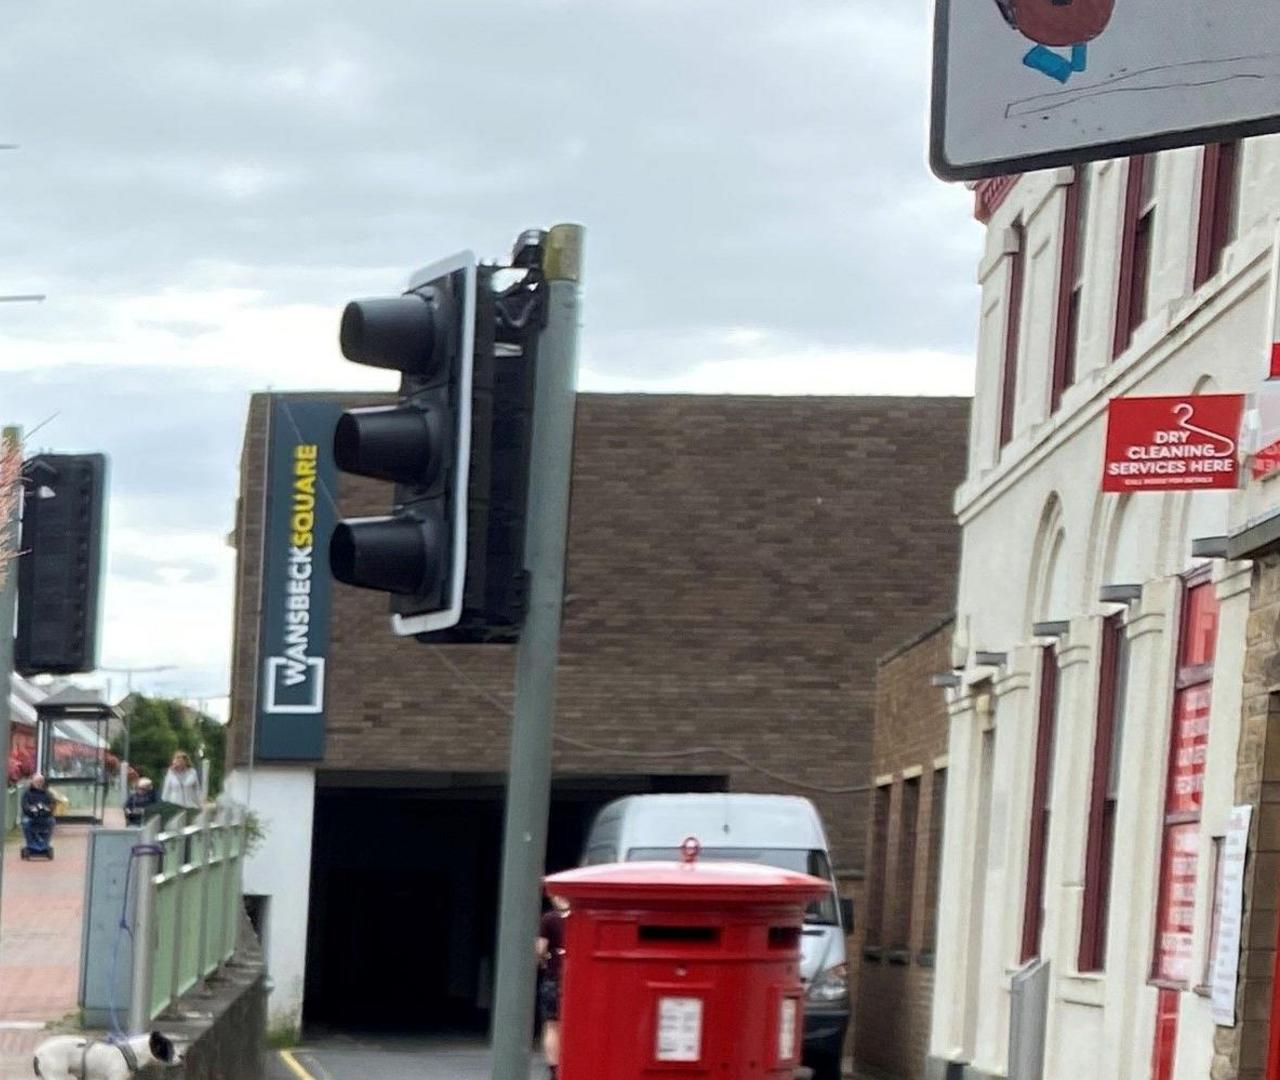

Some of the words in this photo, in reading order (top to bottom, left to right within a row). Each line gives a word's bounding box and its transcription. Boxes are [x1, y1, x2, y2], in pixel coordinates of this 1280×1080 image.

[1155, 431, 1191, 444] DRY
[1127, 445, 1215, 460] CLEANING
[1108, 461, 1186, 476] SERVICES
[1190, 458, 1234, 473] HERE
